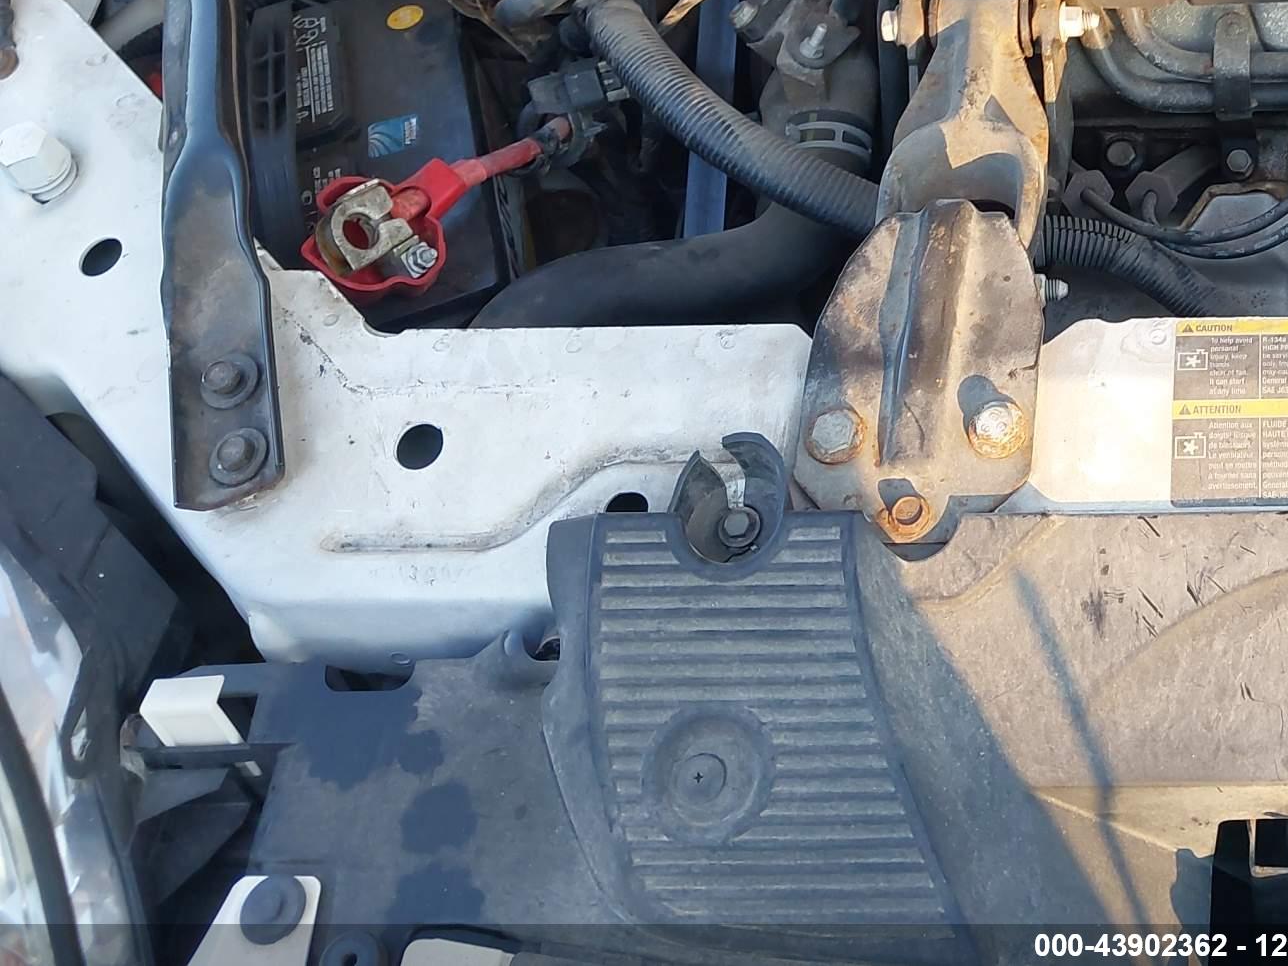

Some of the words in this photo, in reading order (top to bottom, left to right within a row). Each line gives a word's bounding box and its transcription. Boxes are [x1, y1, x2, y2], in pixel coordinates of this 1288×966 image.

[1196, 324, 1233, 332] CAUTION
[1193, 405, 1241, 414] ATTENTION
[1262, 420, 1287, 428] FLUIDE
[1262, 481, 1288, 489] General
